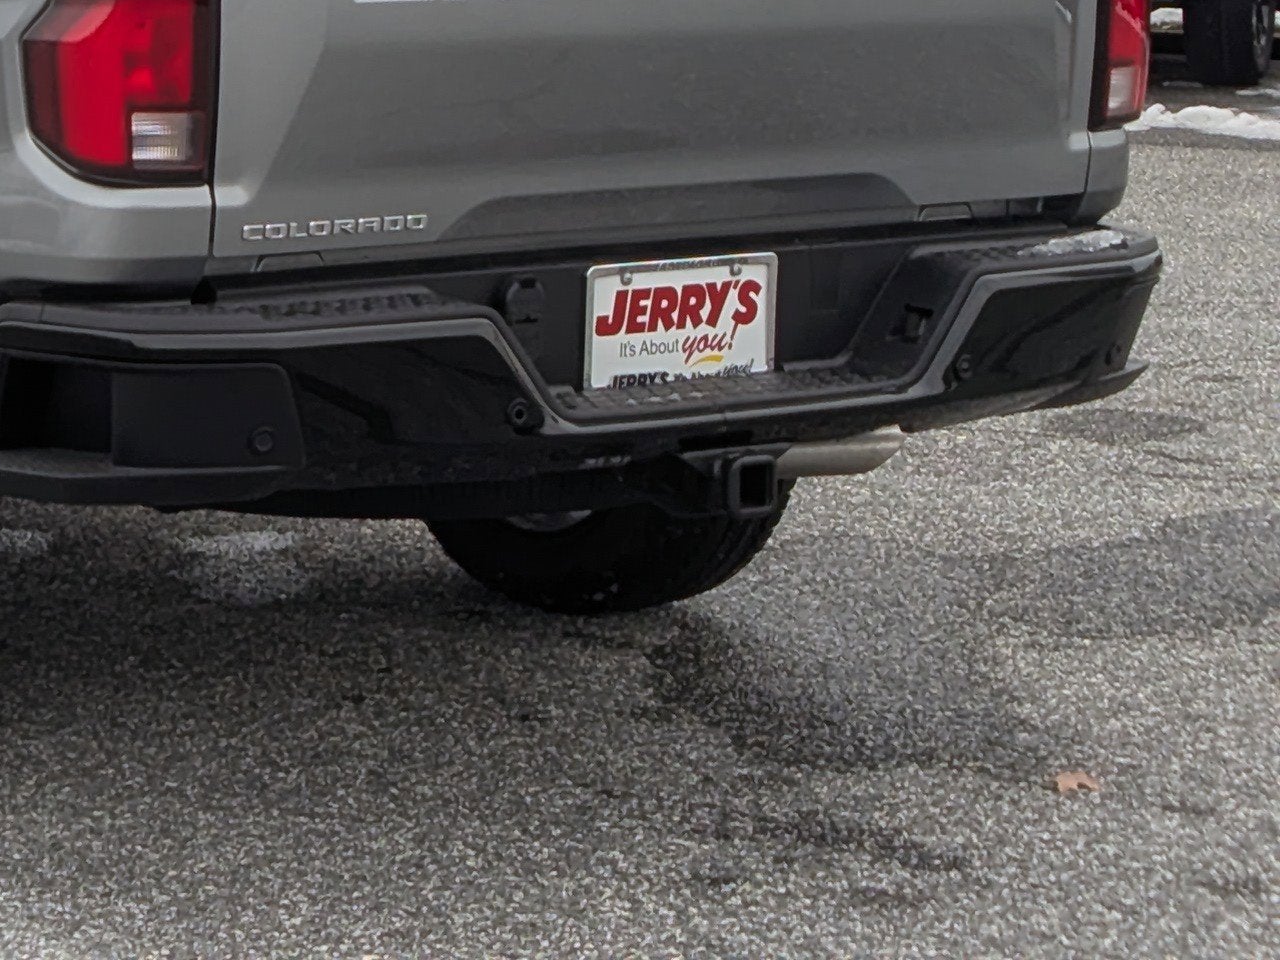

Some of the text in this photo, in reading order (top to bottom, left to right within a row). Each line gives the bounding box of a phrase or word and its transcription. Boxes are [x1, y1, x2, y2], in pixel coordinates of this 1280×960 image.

[242, 214, 428, 240] COLORADO
[595, 279, 762, 336] JERRY'S
[620, 341, 636, 358] It's
[639, 339, 680, 356] About
